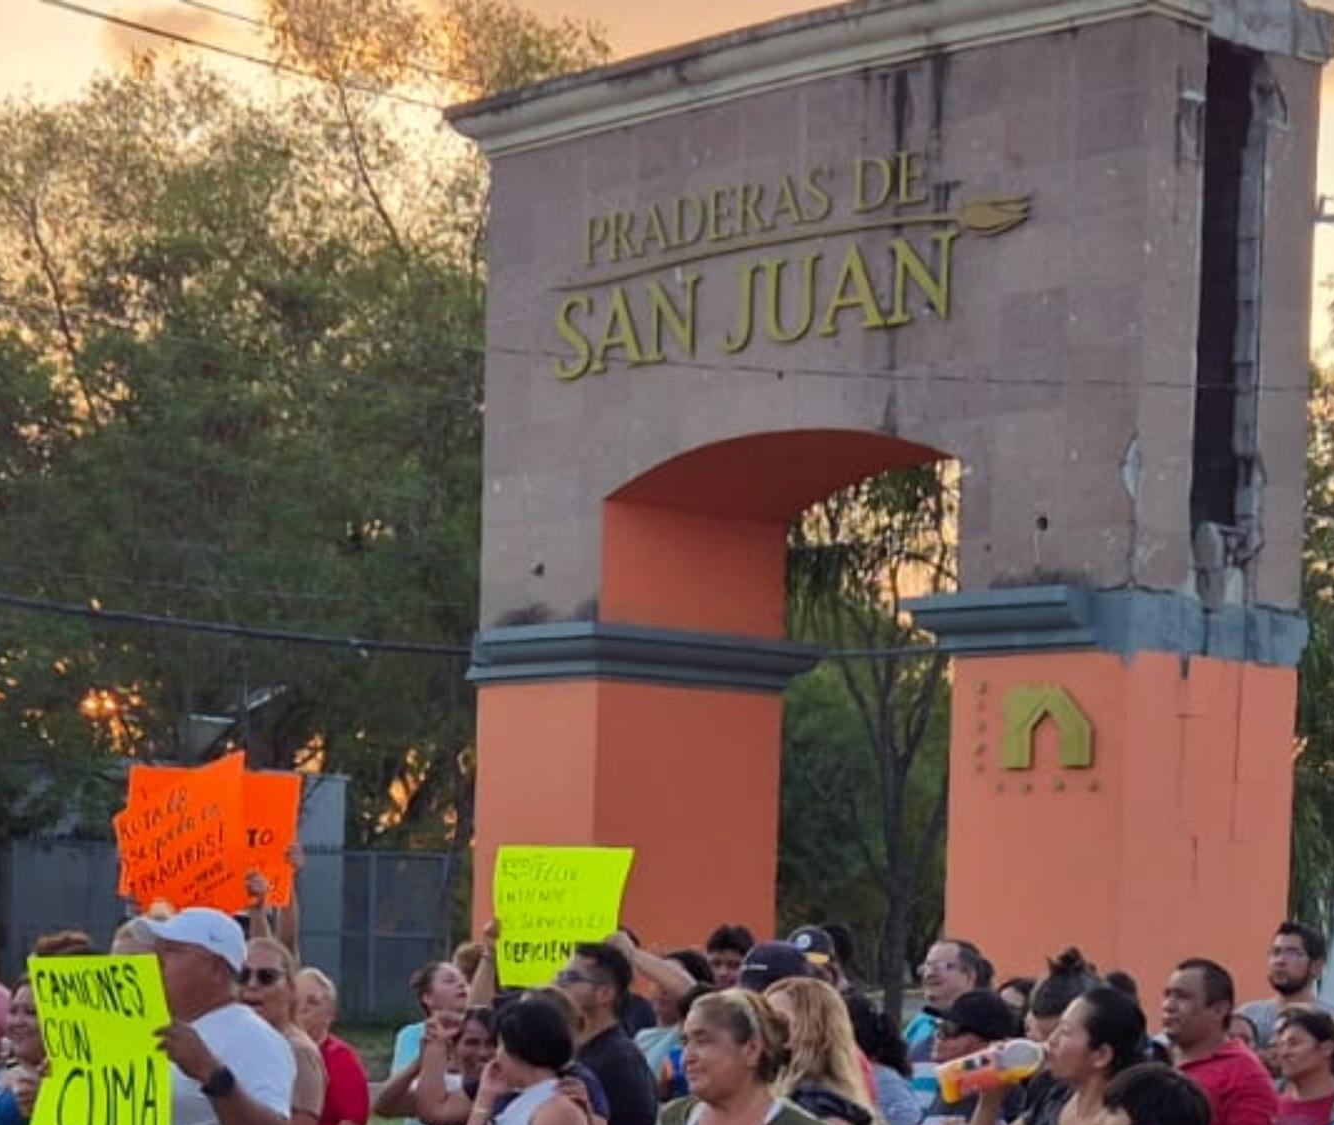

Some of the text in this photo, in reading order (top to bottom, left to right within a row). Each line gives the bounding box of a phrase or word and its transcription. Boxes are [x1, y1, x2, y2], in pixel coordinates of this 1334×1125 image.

[581, 149, 930, 268] PRADERAS DE
[554, 227, 961, 381] SAN JUAN
[503, 938, 572, 964] DEFICIEN
[36, 963, 146, 1019] CAMIONES
[42, 1016, 92, 1064] CON
